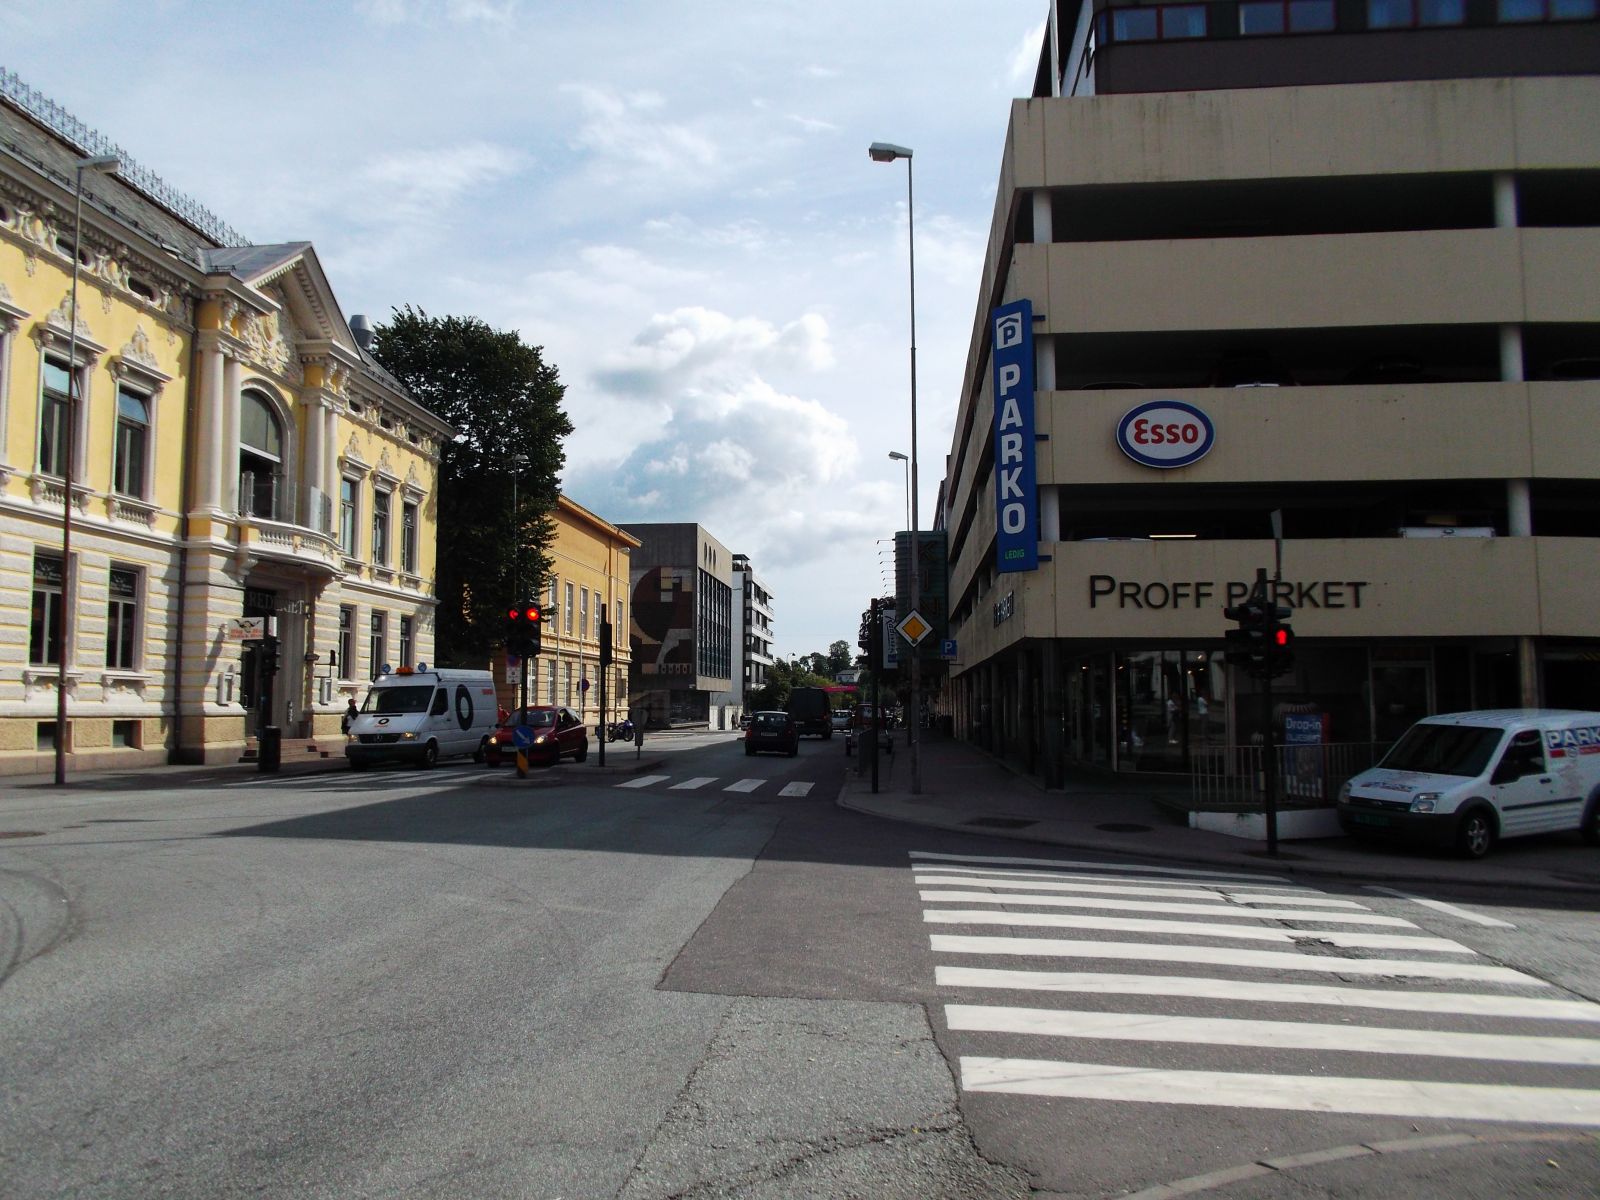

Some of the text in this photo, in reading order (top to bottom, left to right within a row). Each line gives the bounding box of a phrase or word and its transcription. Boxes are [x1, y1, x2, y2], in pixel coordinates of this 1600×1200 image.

[999, 363, 1026, 535] PARKO
[1004, 548, 1025, 560] LEDIG
[1285, 717, 1322, 732] Drop-in
